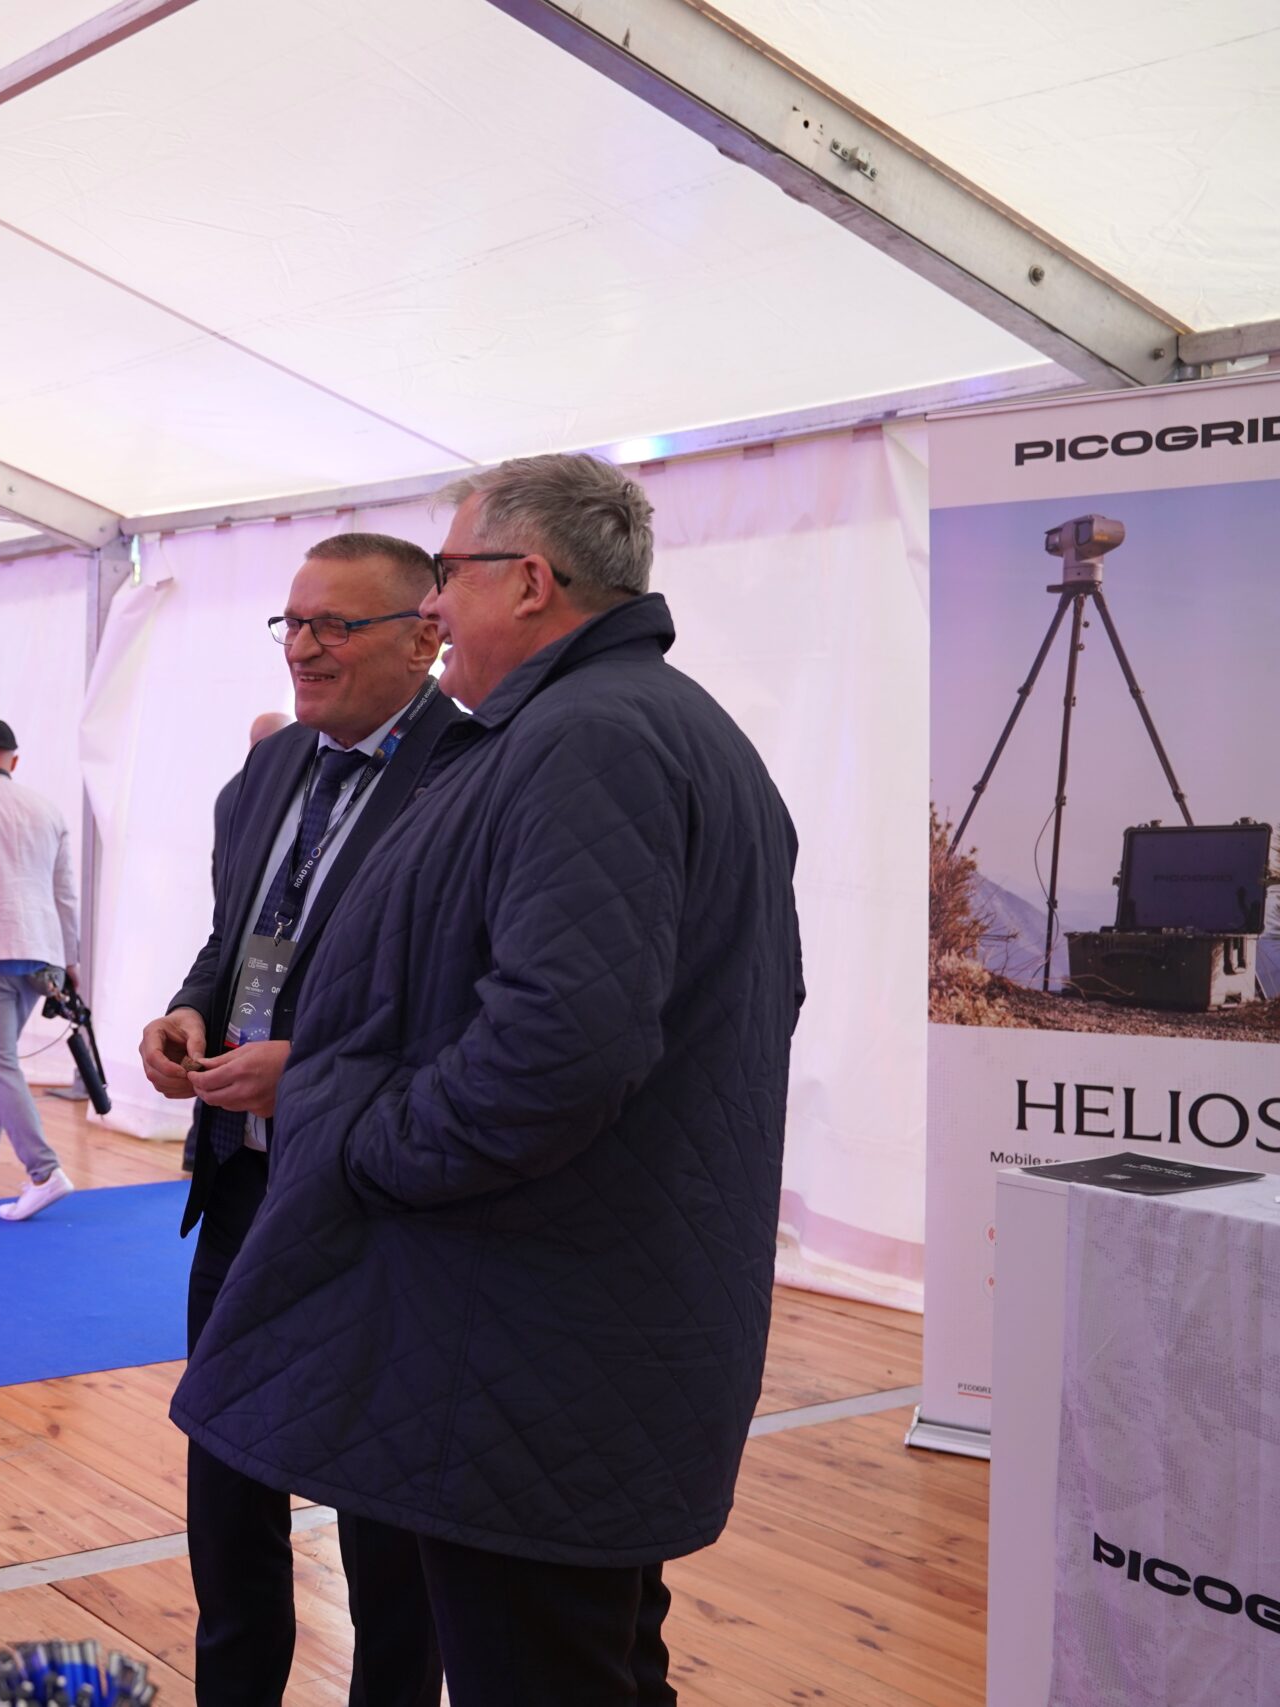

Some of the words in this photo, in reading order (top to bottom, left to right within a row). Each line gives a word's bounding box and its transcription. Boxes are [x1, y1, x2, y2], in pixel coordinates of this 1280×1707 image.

[293, 868, 308, 889] ROAD
[305, 860, 314, 870] TO
[1015, 1078, 1280, 1153] HELIOS
[990, 1151, 1041, 1166] Mobile
